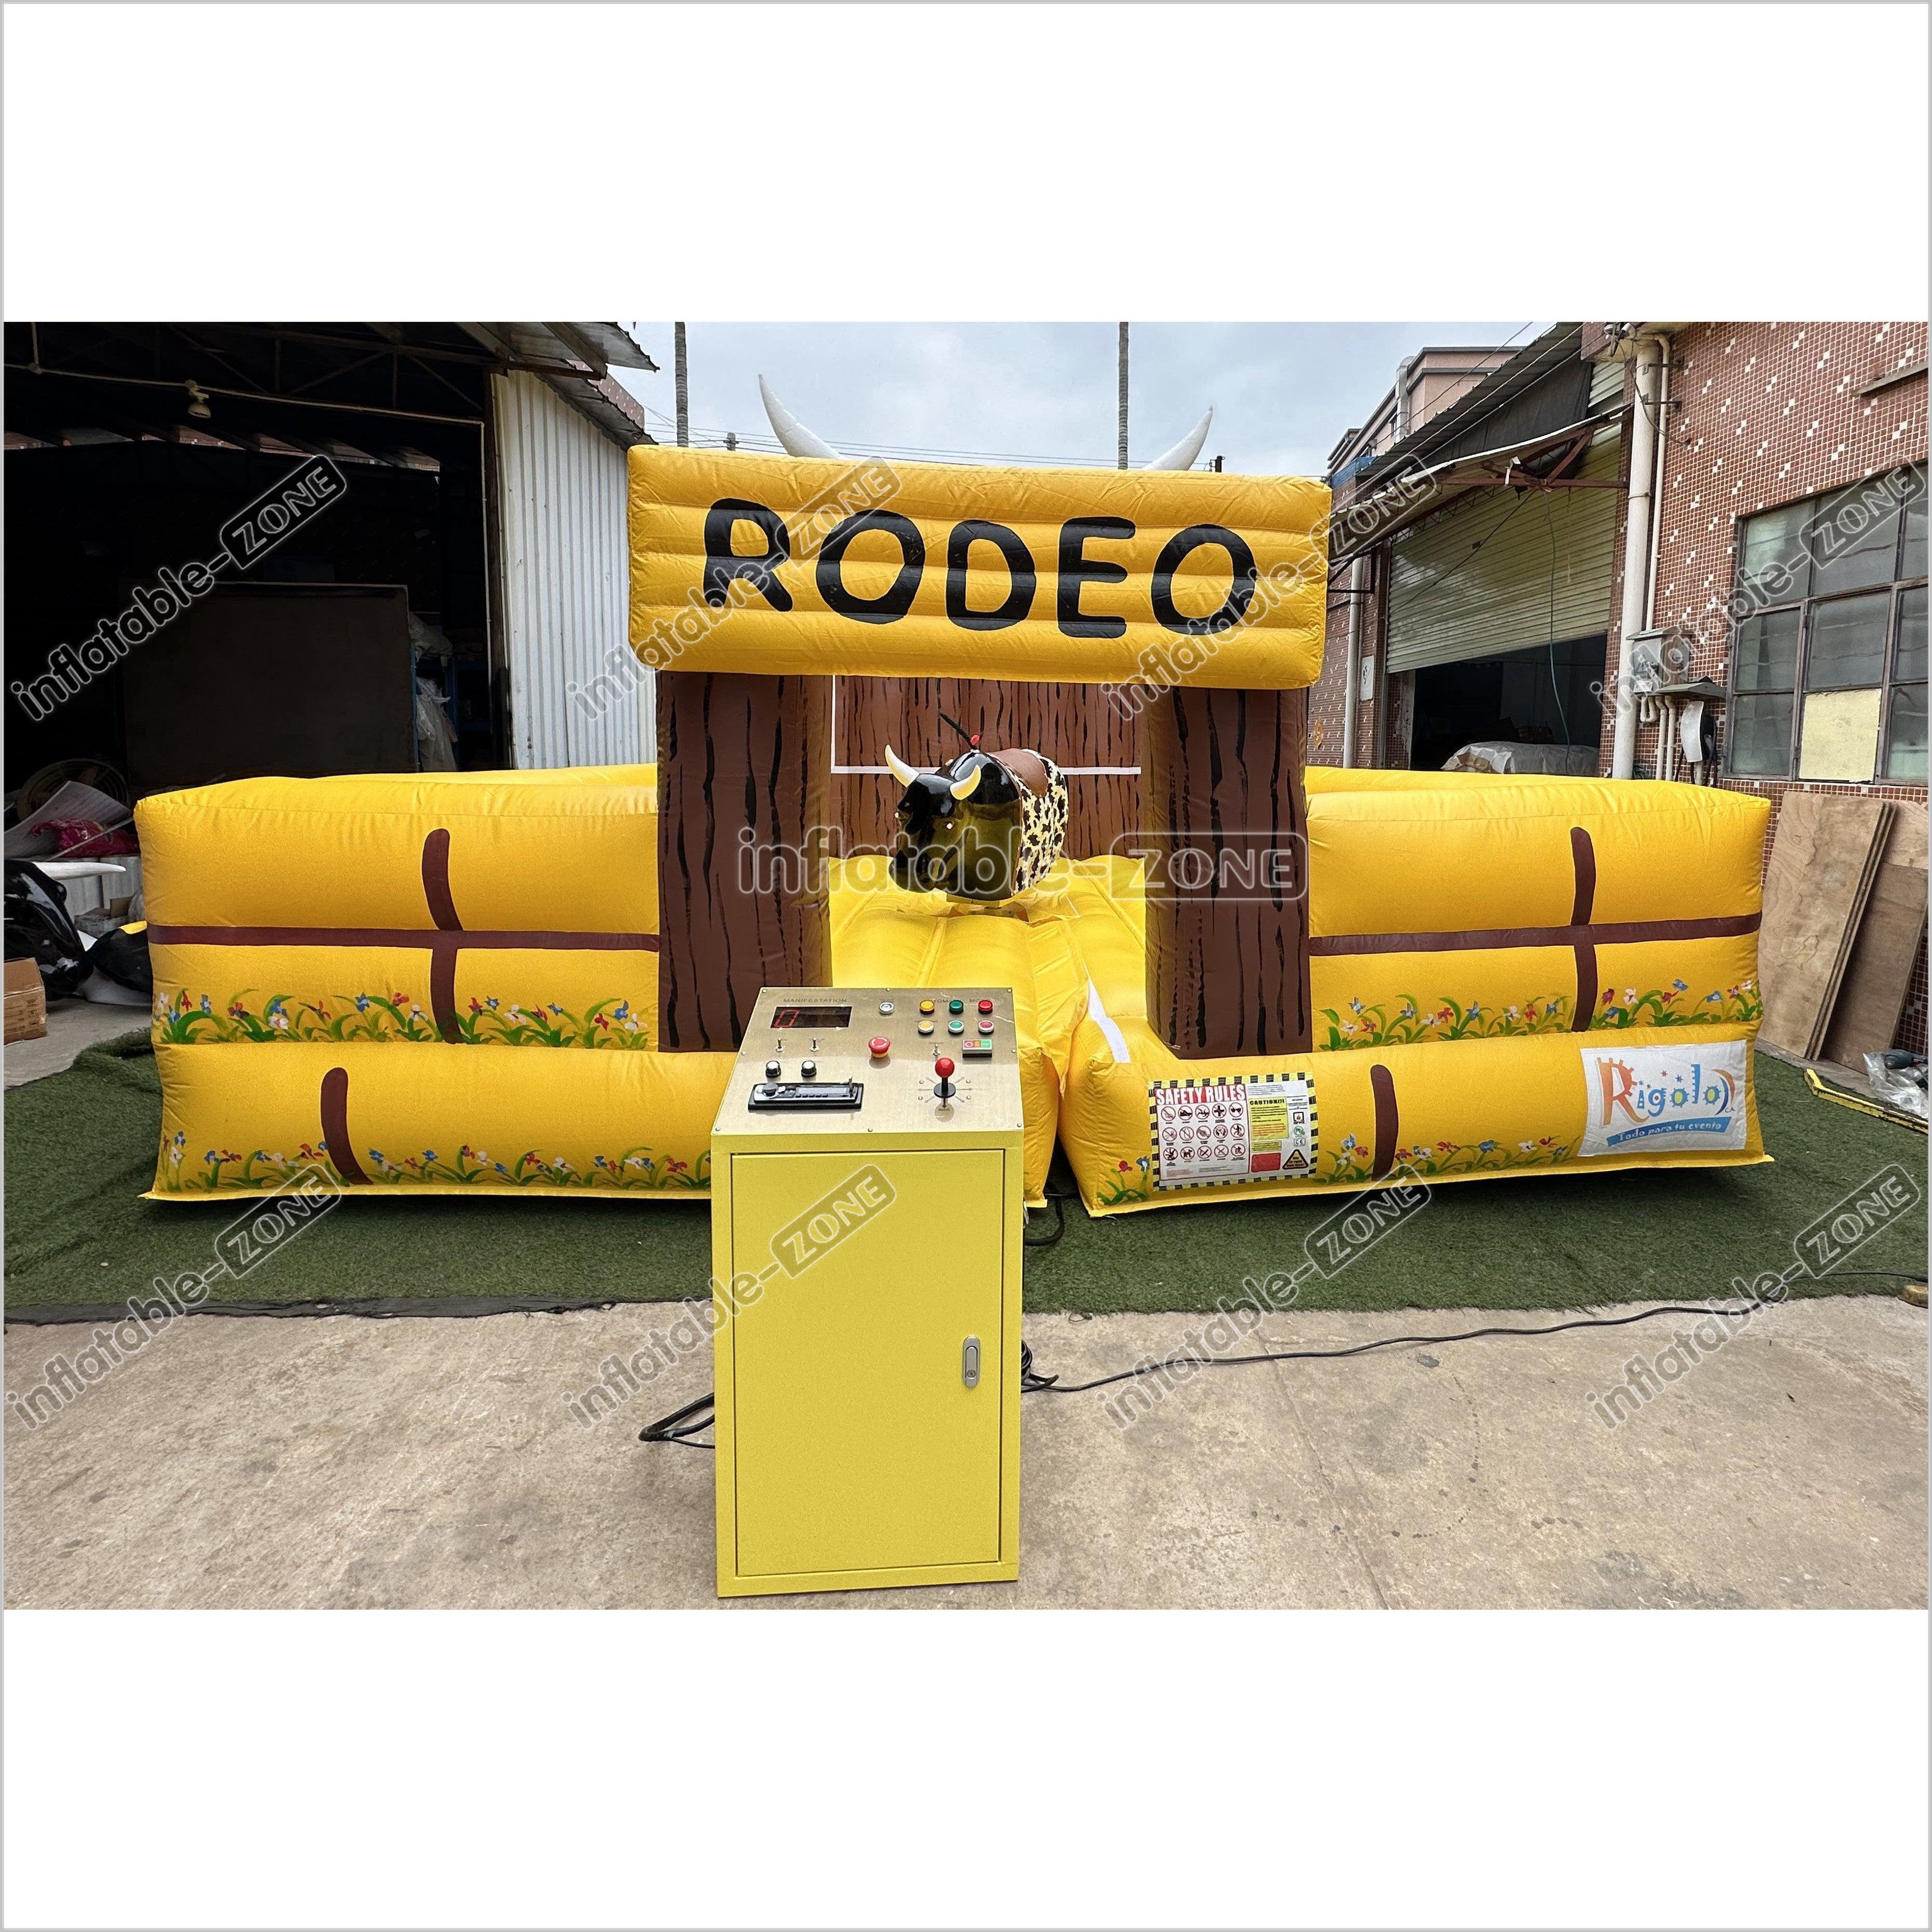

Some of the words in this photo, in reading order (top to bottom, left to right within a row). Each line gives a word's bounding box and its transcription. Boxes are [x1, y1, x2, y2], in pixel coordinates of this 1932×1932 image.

[703, 497, 1257, 639] RODEO
[1156, 1087, 1203, 1105] SAFETY
[1205, 1084, 1246, 1102] RULES
[1597, 1057, 1722, 1126] Rigolo
[1618, 1128, 1645, 1141] Todo
[1648, 1125, 1672, 1136] para
[1688, 1122, 1722, 1130] evento
